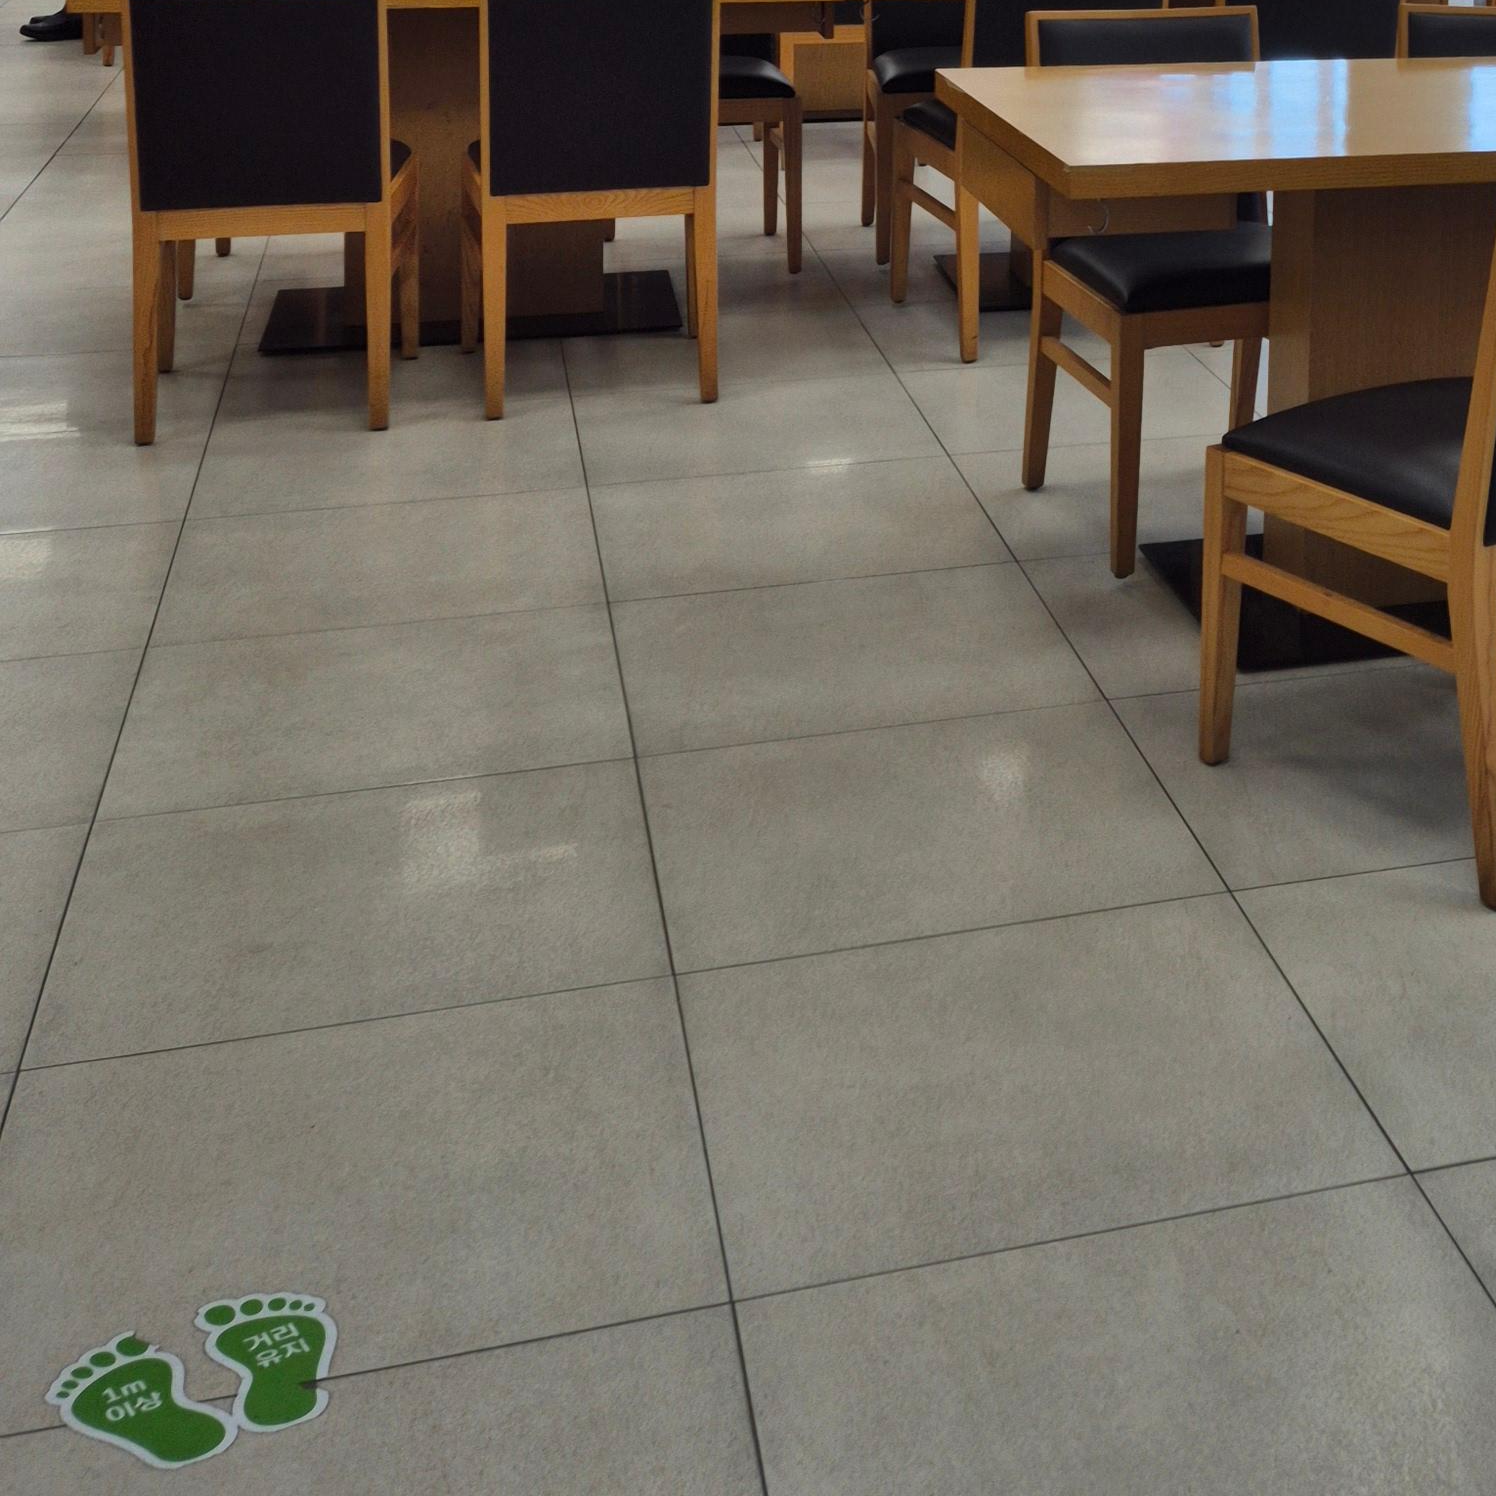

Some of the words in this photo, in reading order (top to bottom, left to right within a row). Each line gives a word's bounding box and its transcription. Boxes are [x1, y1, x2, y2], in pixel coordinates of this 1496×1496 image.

[243, 1321, 299, 1353] 거리
[254, 1338, 311, 1368] 유지
[101, 1379, 148, 1405] 1m
[105, 1391, 164, 1423] 이상
